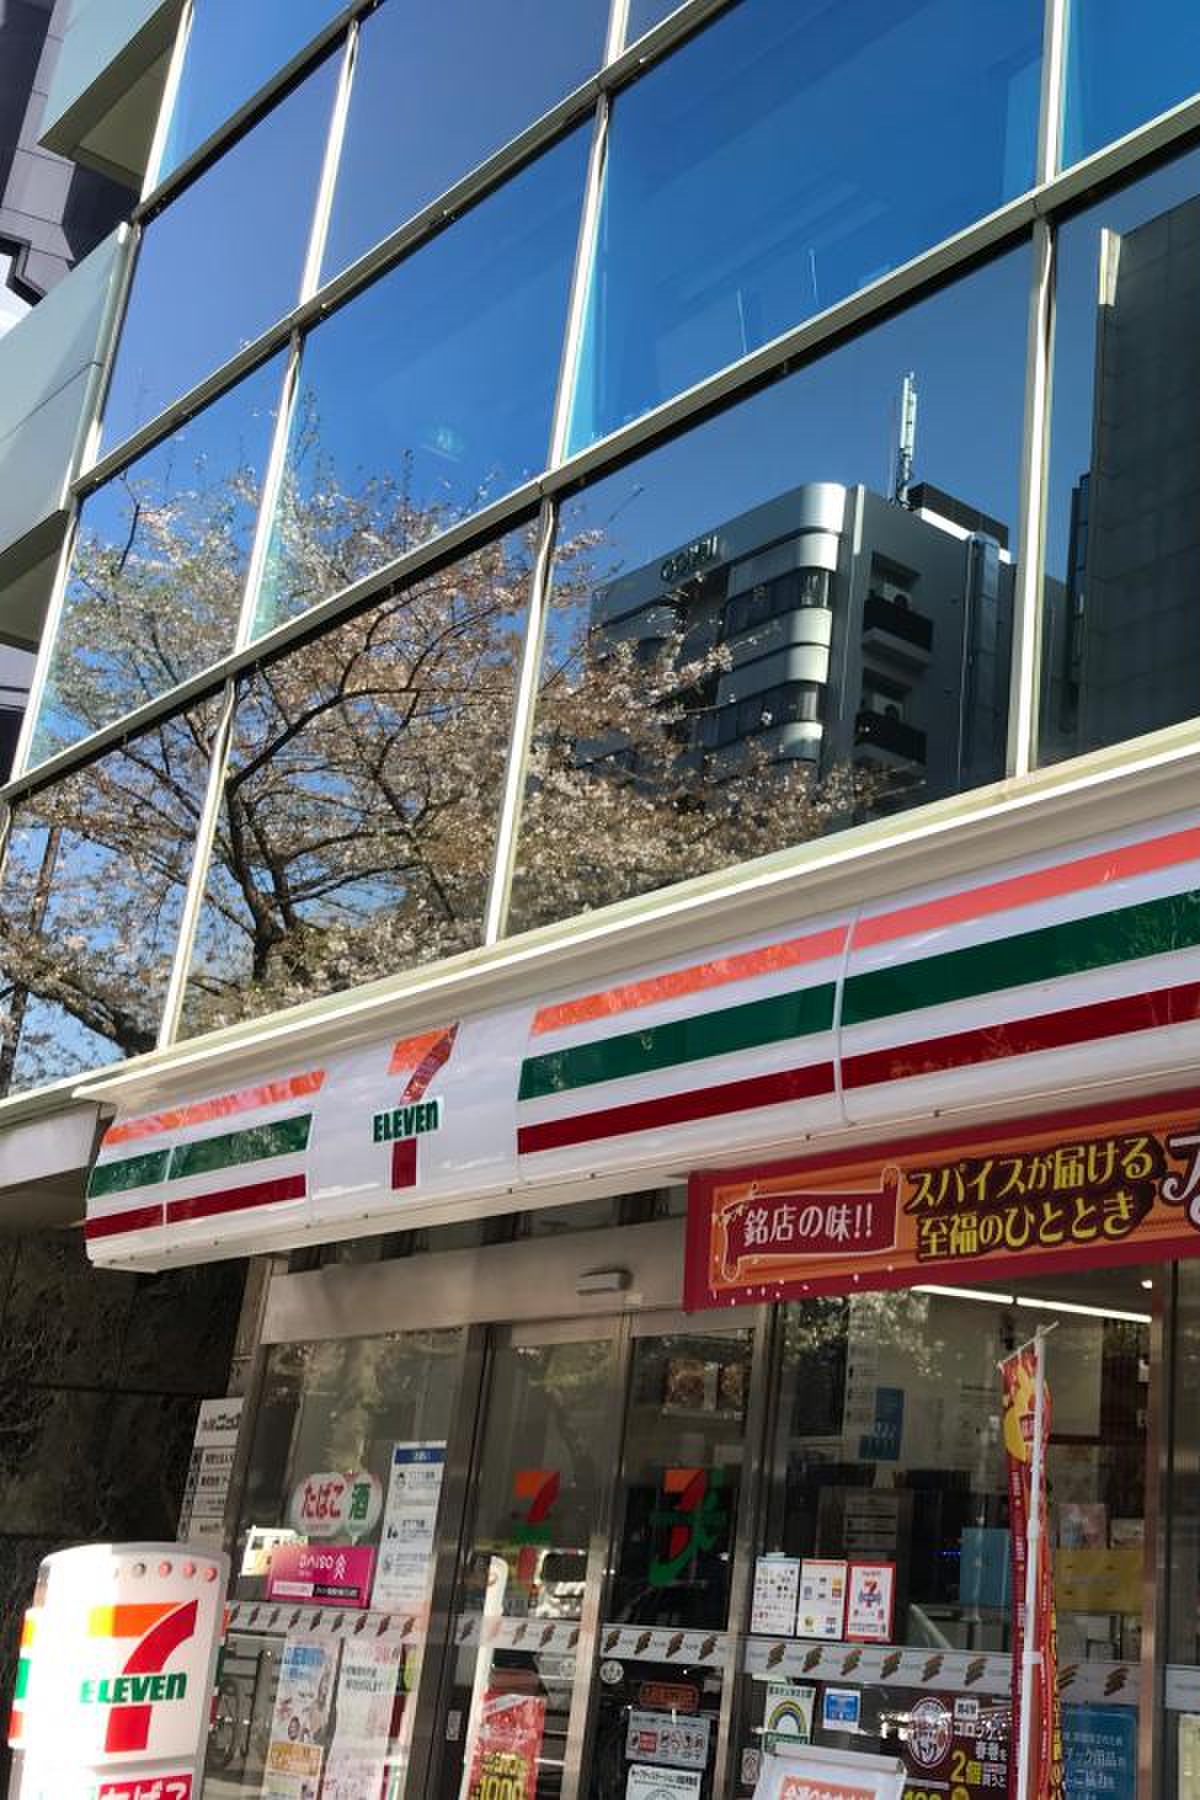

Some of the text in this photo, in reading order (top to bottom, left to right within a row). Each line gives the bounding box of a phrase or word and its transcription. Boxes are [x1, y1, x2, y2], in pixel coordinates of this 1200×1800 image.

[906, 1137, 1154, 1210] スパイスが届ける
[919, 1190, 1138, 1259] 至福のひととき
